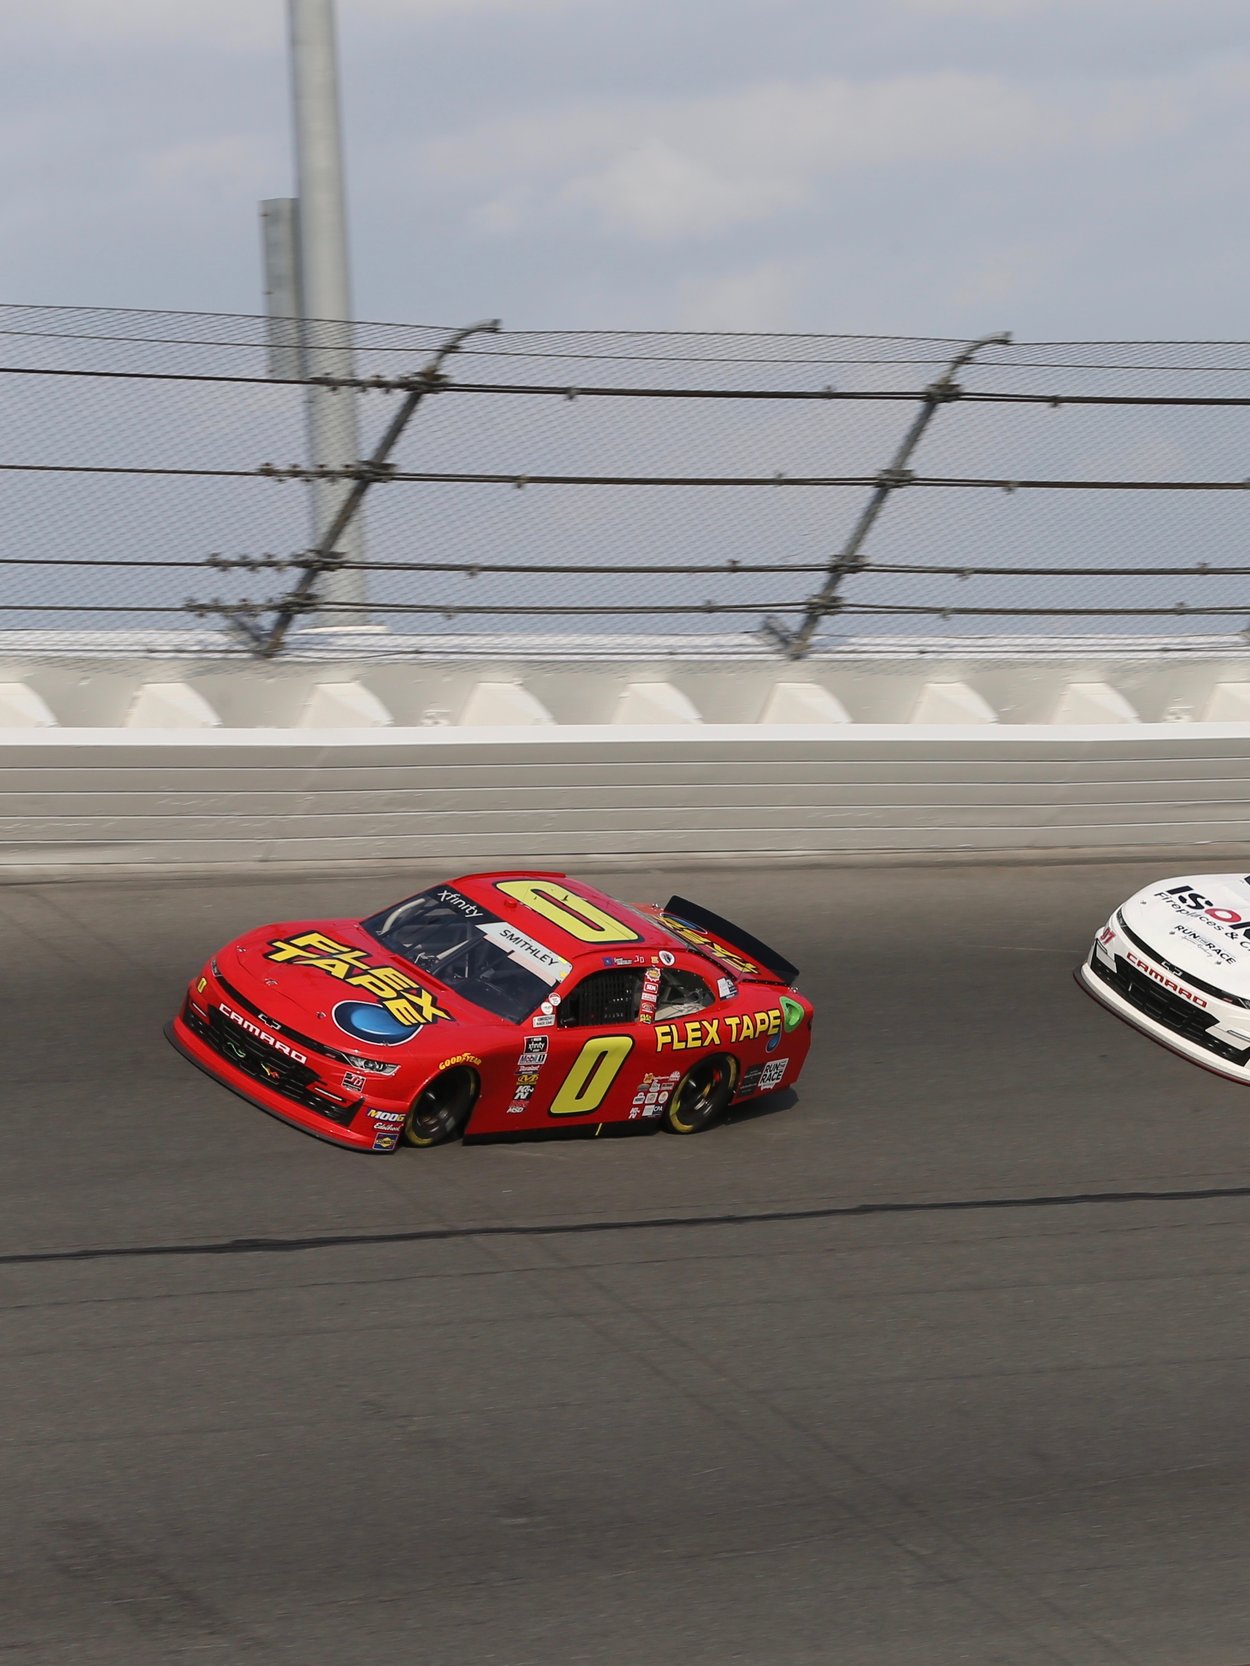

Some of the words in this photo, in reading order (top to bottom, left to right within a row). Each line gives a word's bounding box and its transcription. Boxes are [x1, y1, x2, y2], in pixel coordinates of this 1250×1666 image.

[437, 889, 484, 918] xfinity
[496, 880, 639, 942] 0
[1154, 891, 1225, 932] Fireplaces
[1224, 931, 1240, 940] &
[499, 928, 559, 967] SMITHLEY
[1100, 927, 1117, 945] 07
[1174, 924, 1201, 940] RUN
[1205, 942, 1237, 965] RACE
[268, 940, 428, 1026] TAPE
[289, 932, 451, 1023] FLEX
[1126, 951, 1208, 1009] CAMARO
[218, 1002, 308, 1065] CAMARO
[655, 1019, 721, 1052] FLEX
[725, 1009, 781, 1043] TAPE
[438, 1052, 482, 1071] GOODYEAR
[549, 1036, 633, 1115] 0
[760, 1072, 784, 1084] RACE
[764, 1062, 780, 1073] RUN
[367, 1108, 406, 1122] MOOG
